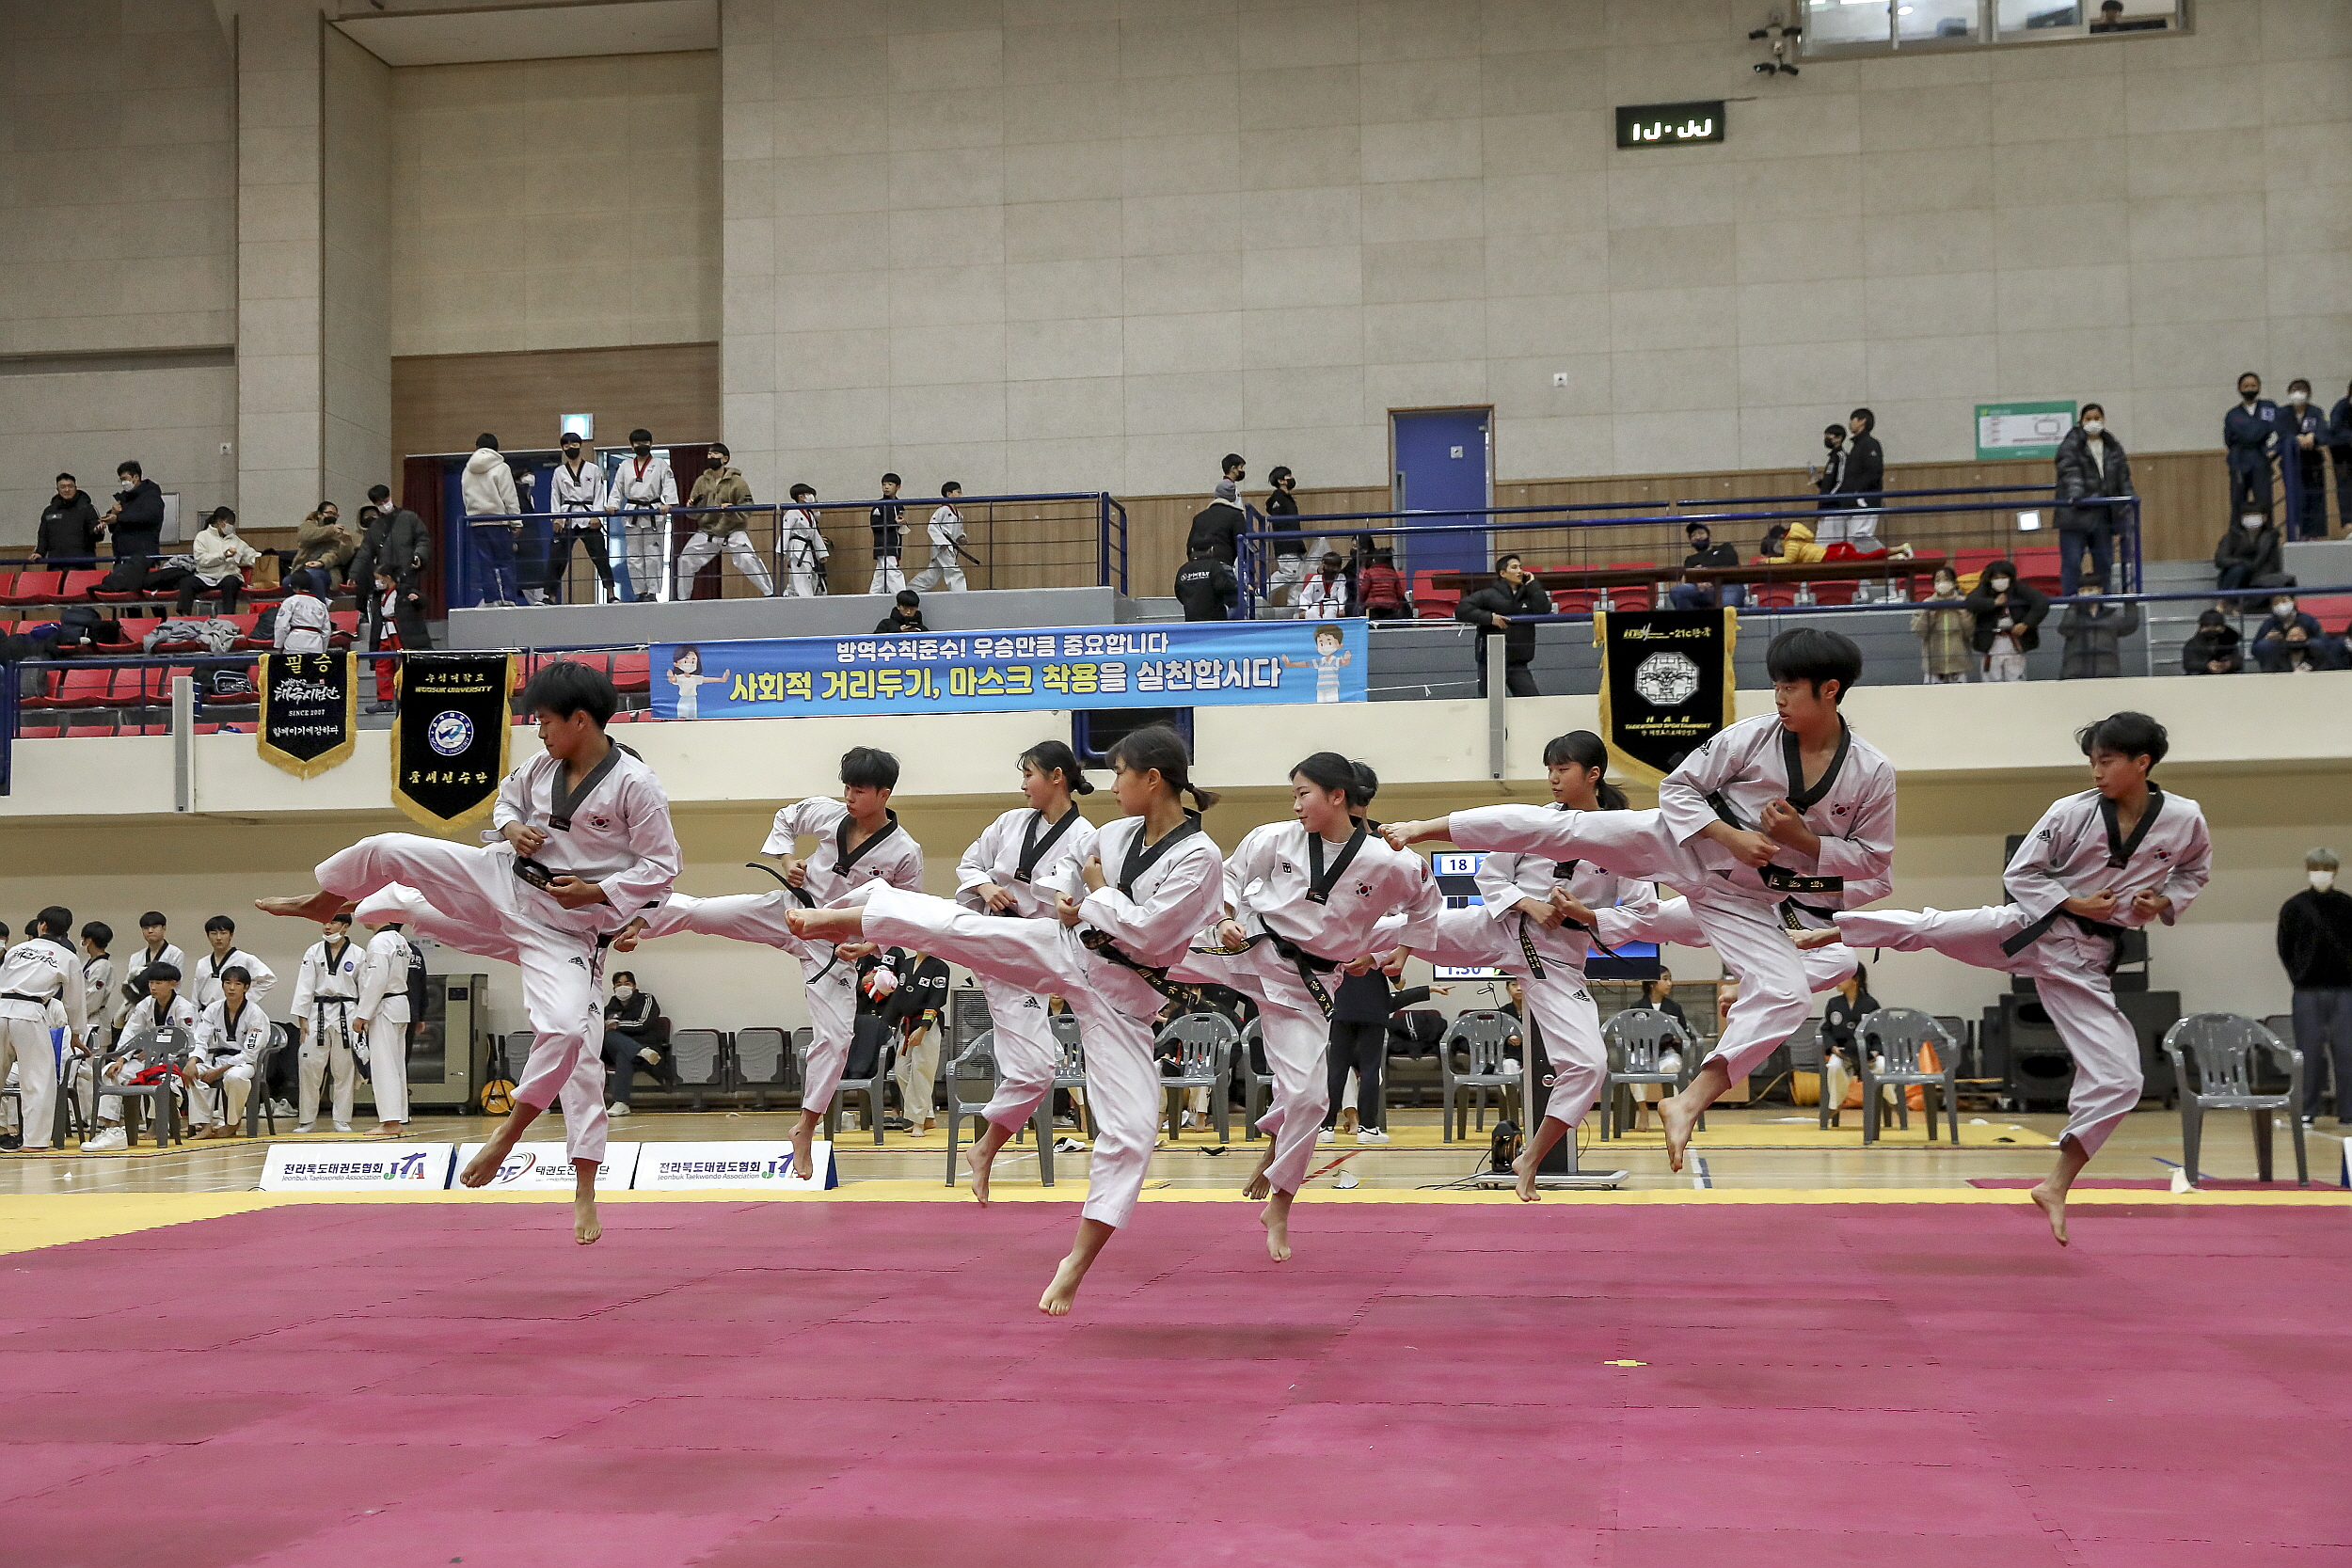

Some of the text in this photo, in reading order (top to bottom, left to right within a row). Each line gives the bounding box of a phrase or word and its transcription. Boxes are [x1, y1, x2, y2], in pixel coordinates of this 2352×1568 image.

[836, 631, 1169, 663] 방역수칙준수! 우승만큼 중요합니다
[729, 657, 1281, 702] 사회적 거리두기, 마스크 착용을 실천합시다
[1450, 859, 1468, 871] 18
[284, 1163, 384, 1174] 전라북도태권도협회
[660, 1161, 761, 1173] 전라북도태권도협회
